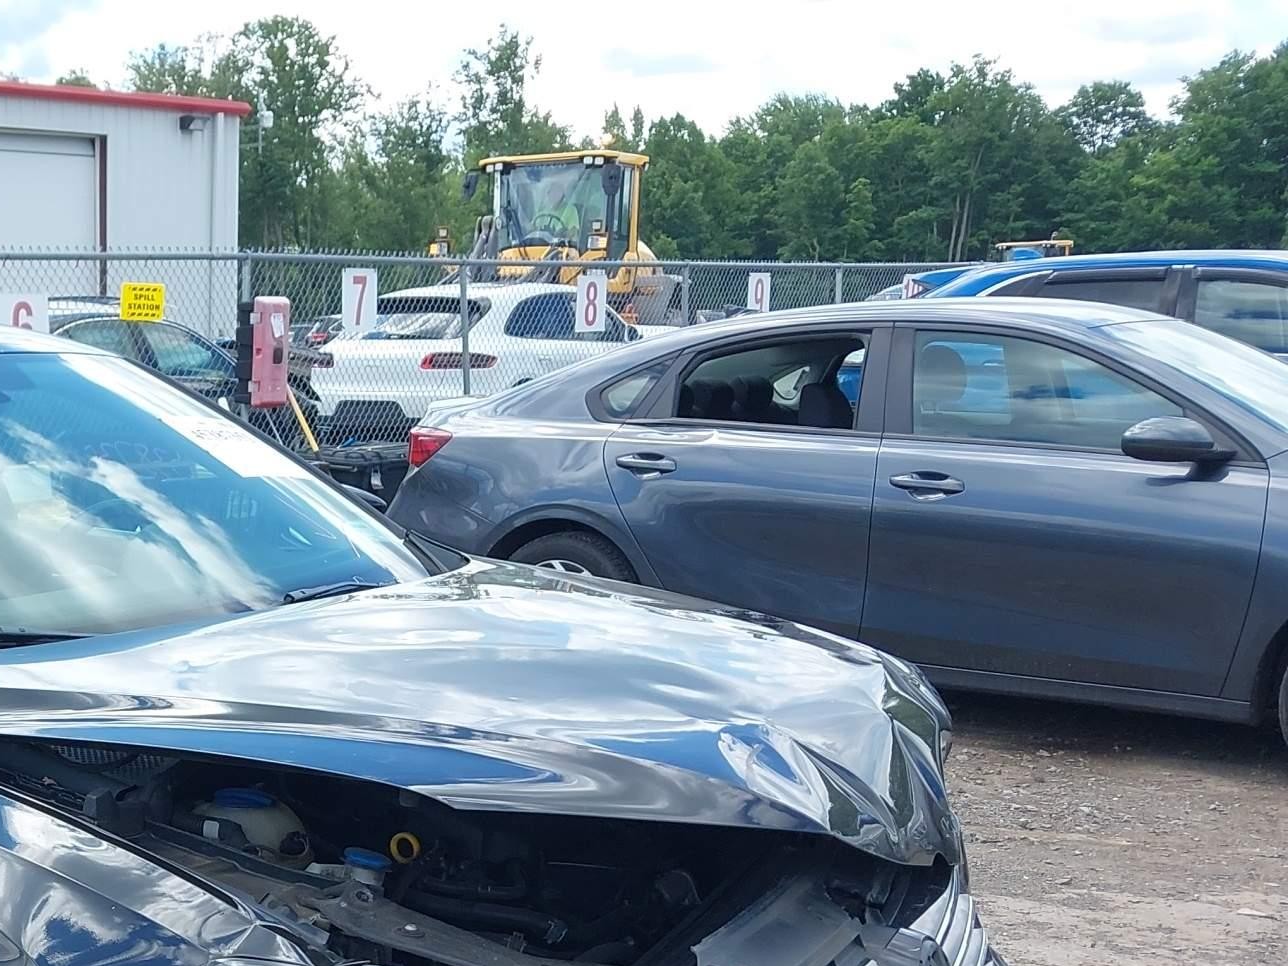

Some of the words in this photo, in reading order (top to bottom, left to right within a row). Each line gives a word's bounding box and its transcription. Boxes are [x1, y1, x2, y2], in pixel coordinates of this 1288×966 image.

[133, 293, 156, 301] SPILL
[353, 275, 367, 326] 7
[584, 281, 598, 327] 8
[754, 278, 765, 312] 9
